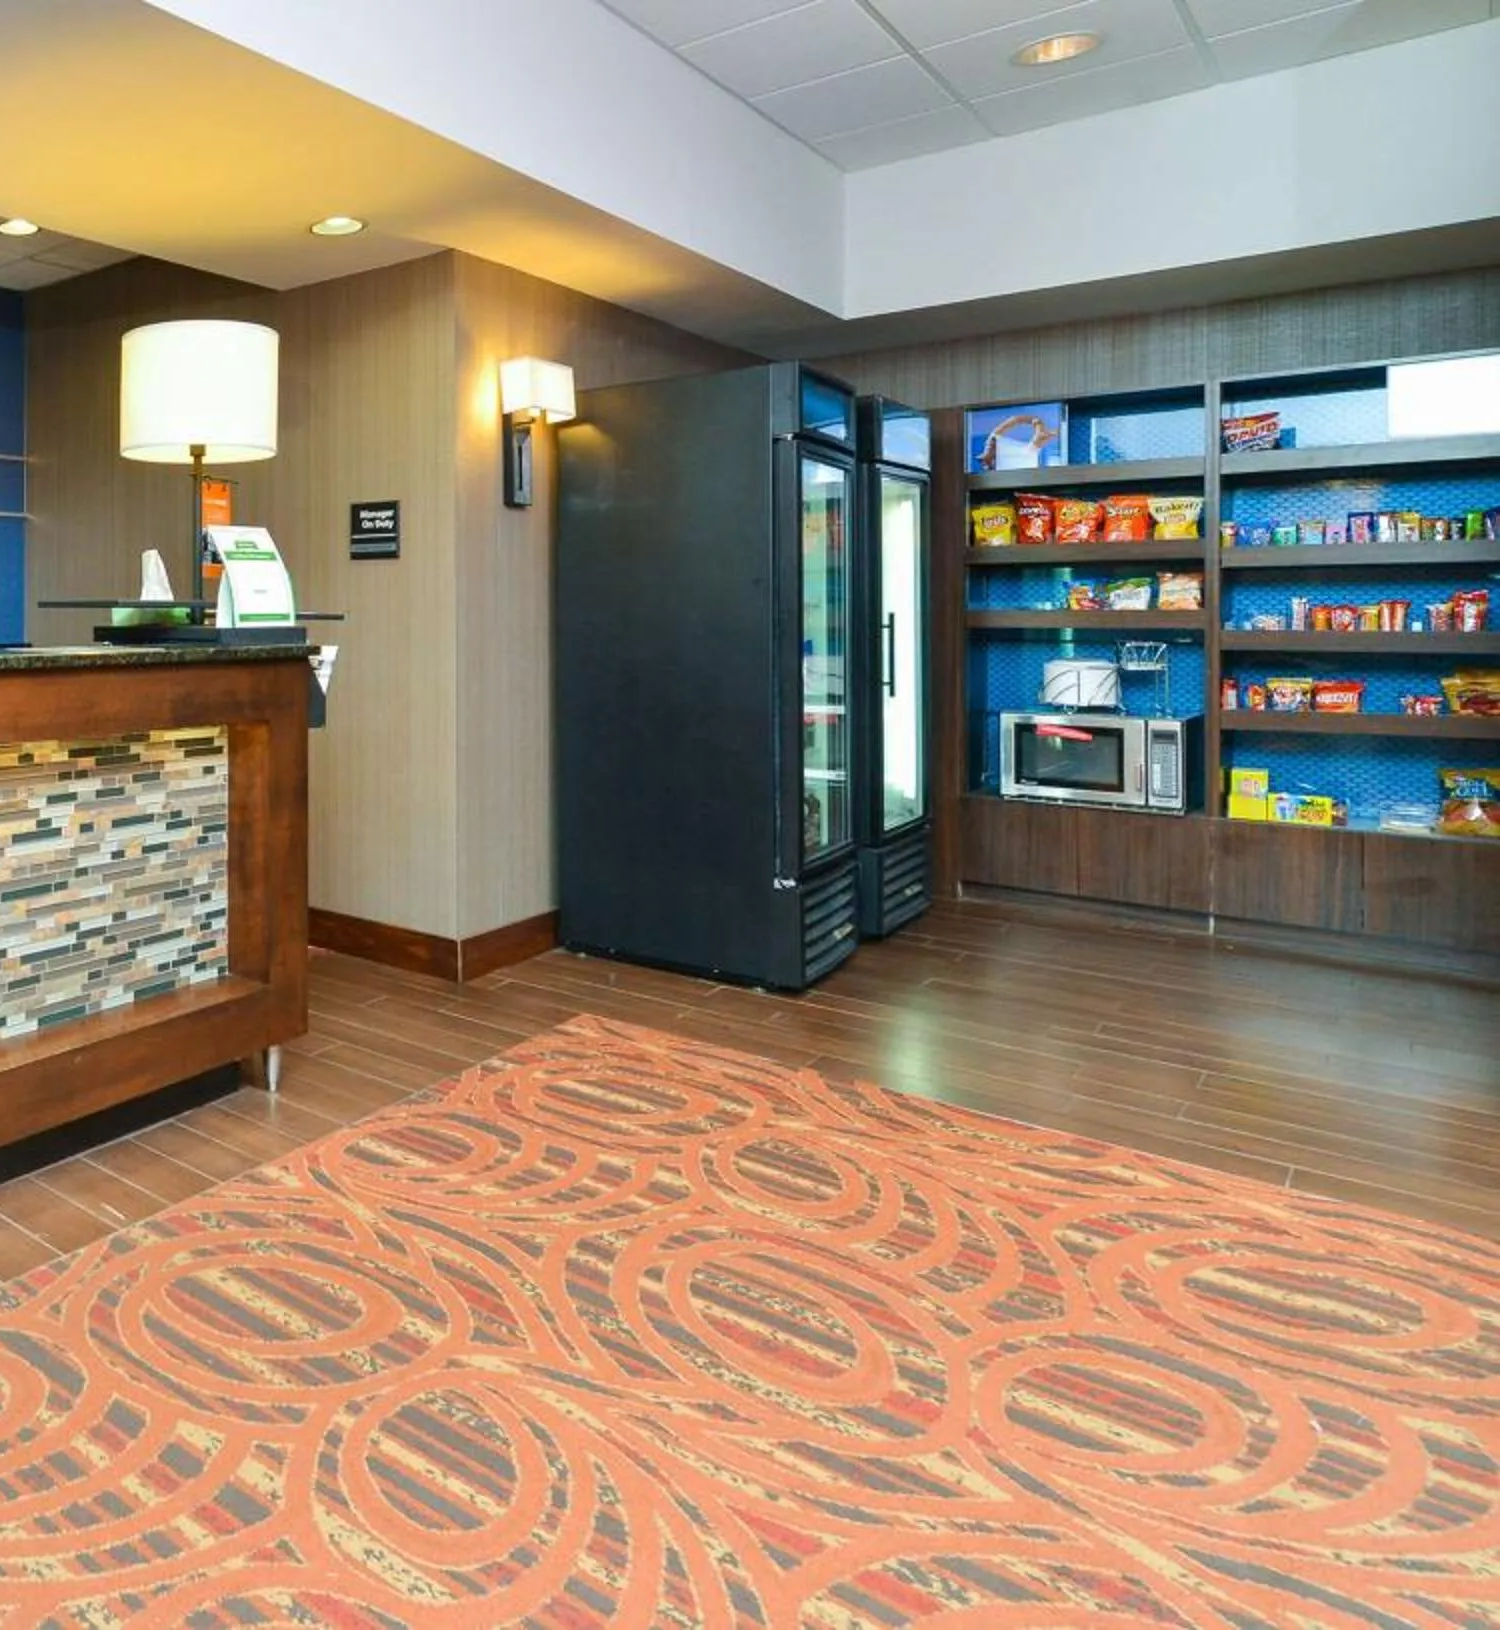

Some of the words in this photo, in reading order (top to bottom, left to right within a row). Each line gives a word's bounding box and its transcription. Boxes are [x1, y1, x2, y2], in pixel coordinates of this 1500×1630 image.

[359, 509, 395, 520] Manager
[361, 519, 374, 529] On
[375, 519, 395, 529] Duty
